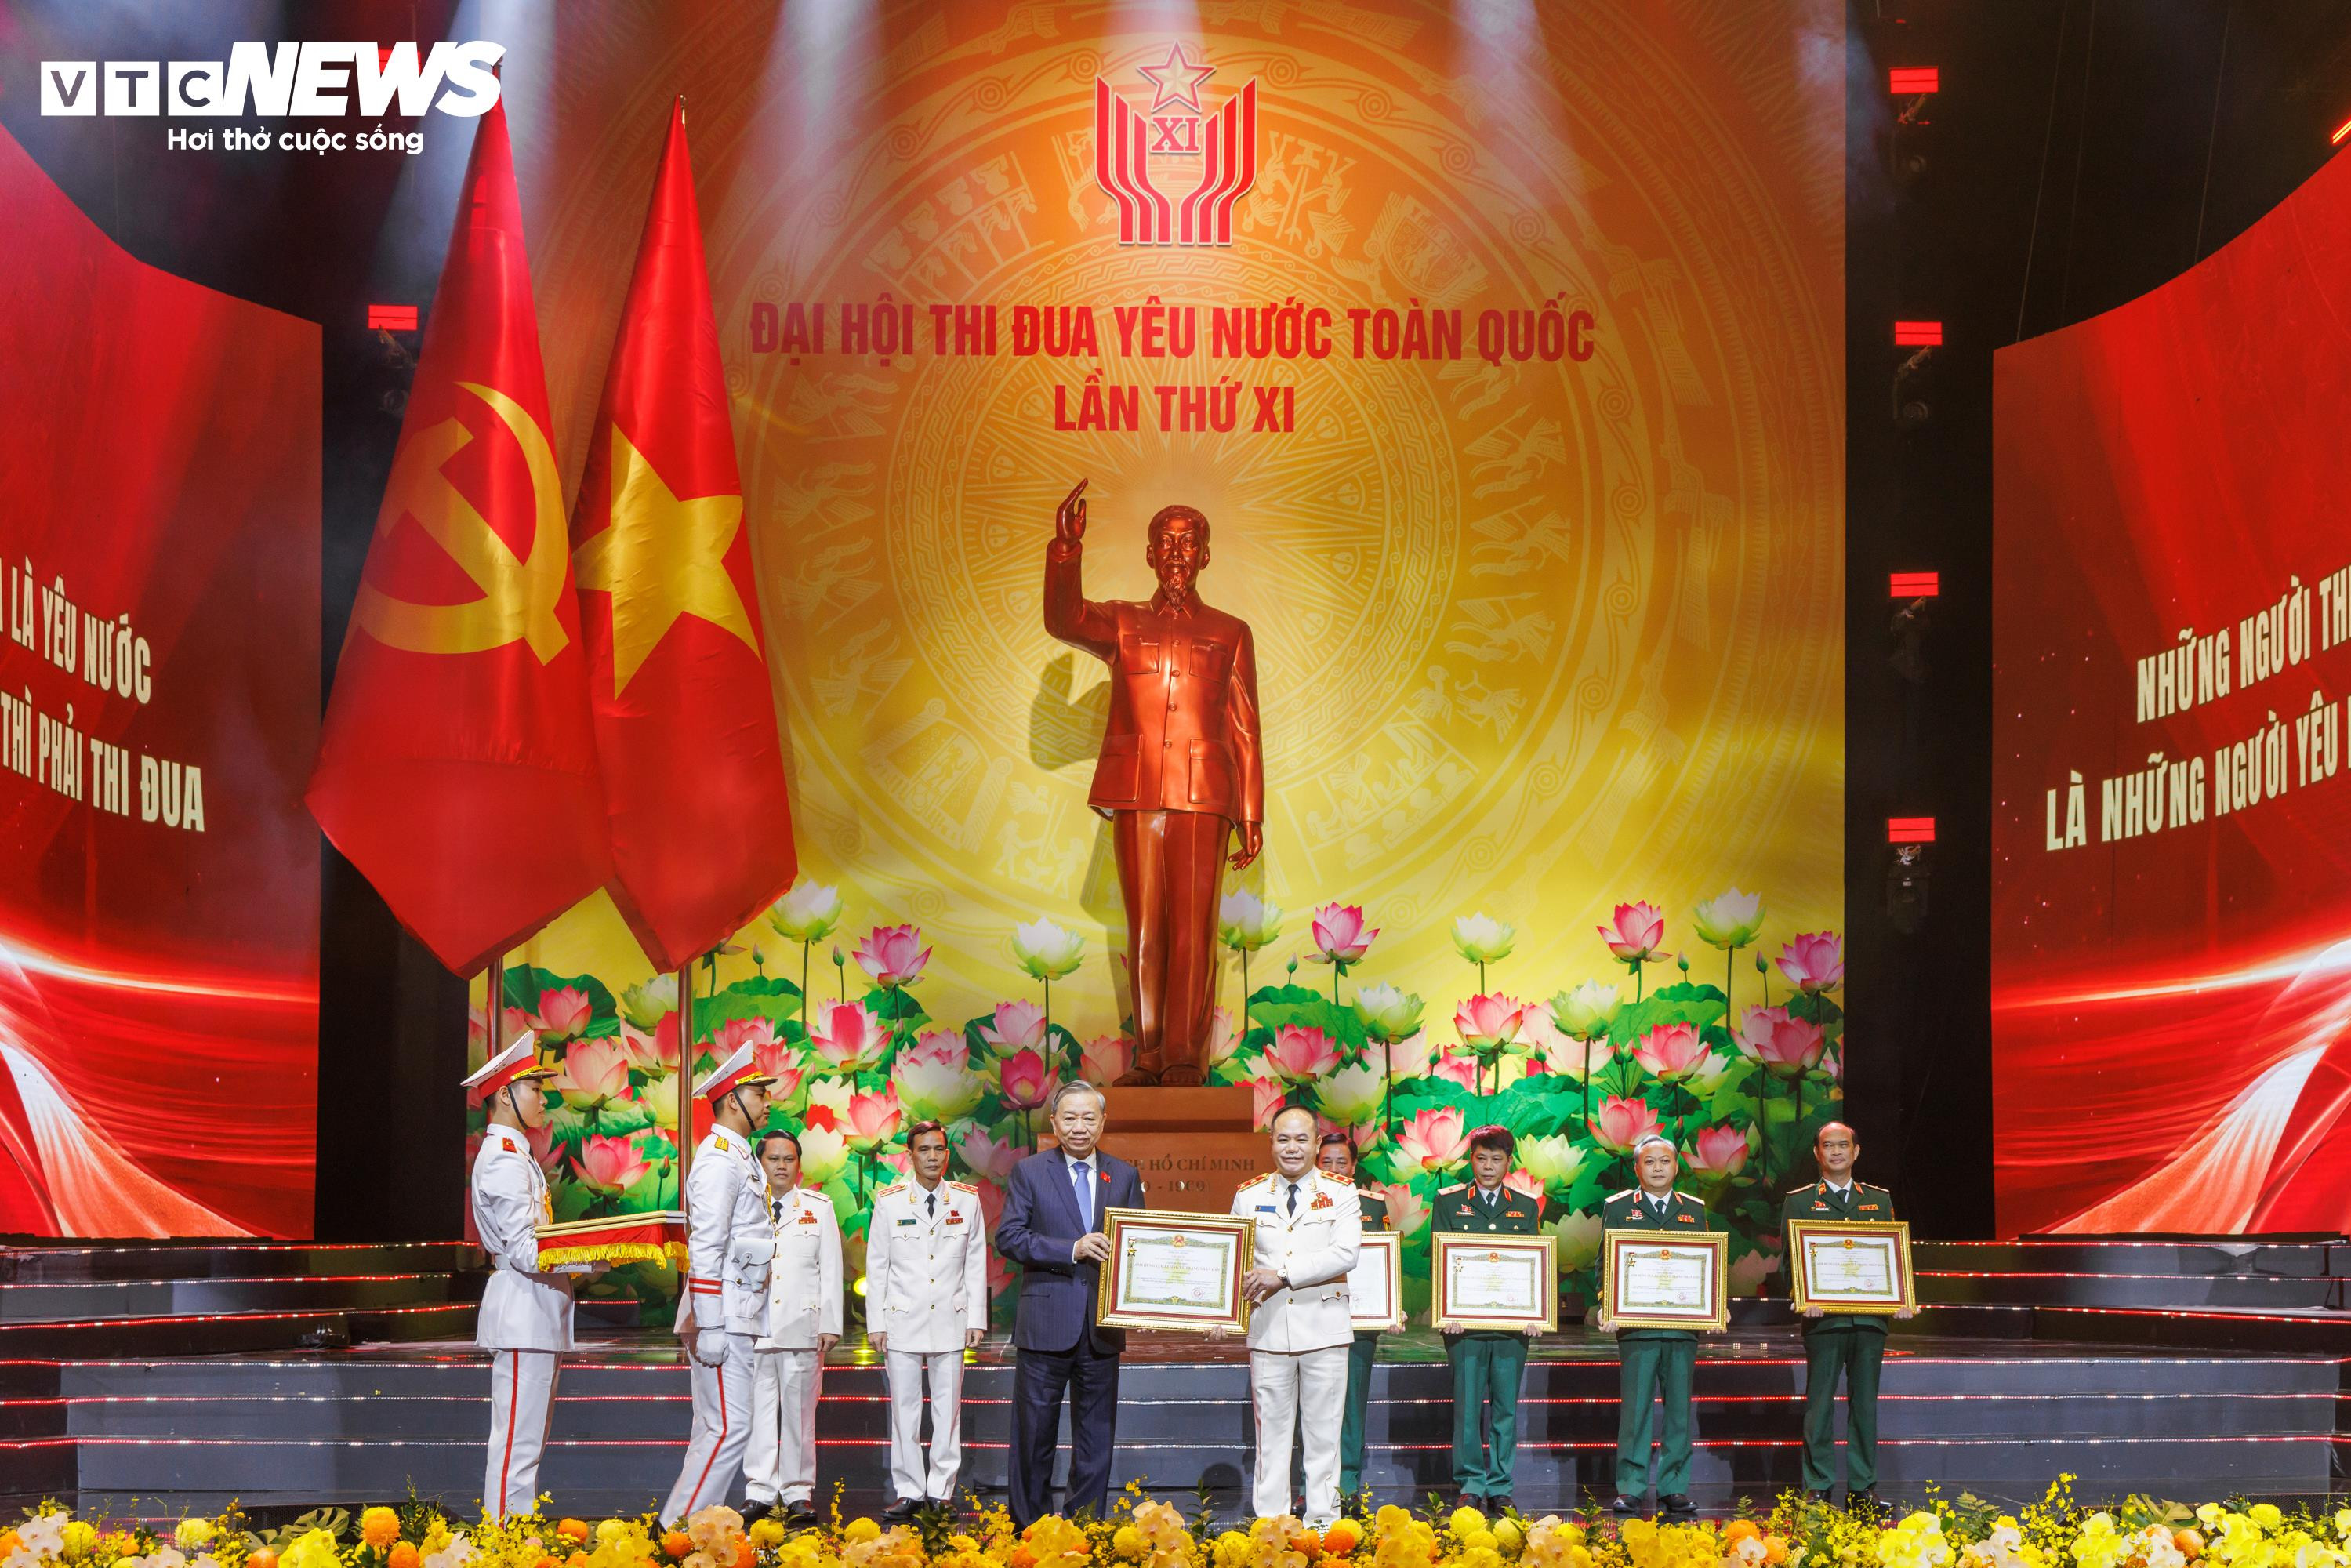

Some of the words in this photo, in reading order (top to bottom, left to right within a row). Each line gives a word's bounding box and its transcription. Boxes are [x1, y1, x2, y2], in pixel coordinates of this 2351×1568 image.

[1150, 115, 1201, 153] XI
[749, 302, 824, 366] ĐẠI
[841, 292, 913, 367] HỘI
[930, 304, 996, 356] THI
[1011, 305, 1099, 358] ĐUA
[1113, 295, 1195, 358] YÊU
[1212, 296, 1332, 360] NƯỚC
[1347, 297, 1462, 361] TOÀN
[1478, 292, 1595, 367] QUỐC
[1054, 368, 1139, 431] LẦN
[1154, 376, 1243, 433] THỨ
[1251, 386, 1294, 433] XI
[11, 555, 34, 652] LÀ
[42, 575, 77, 674] YÊU
[84, 612, 151, 705] NƯỚC
[2137, 627, 2230, 724] NHỮNG
[2240, 574, 2310, 689] NGƯỜI
[2319, 564, 2351, 652] TH
[0, 684, 31, 778] THÌ
[39, 702, 82, 801] PHẢI
[90, 738, 129, 817] THI
[140, 754, 205, 833] ĐUA
[2047, 769, 2087, 851] LÀ
[2102, 751, 2205, 843] NHỮNG
[2215, 709, 2288, 817] NGƯỜI
[2296, 689, 2338, 788] YÊU
[1150, 1153, 1173, 1171] HỒ
[1177, 1156, 1206, 1171] CHÍ
[1210, 1159, 1254, 1171] MINH
